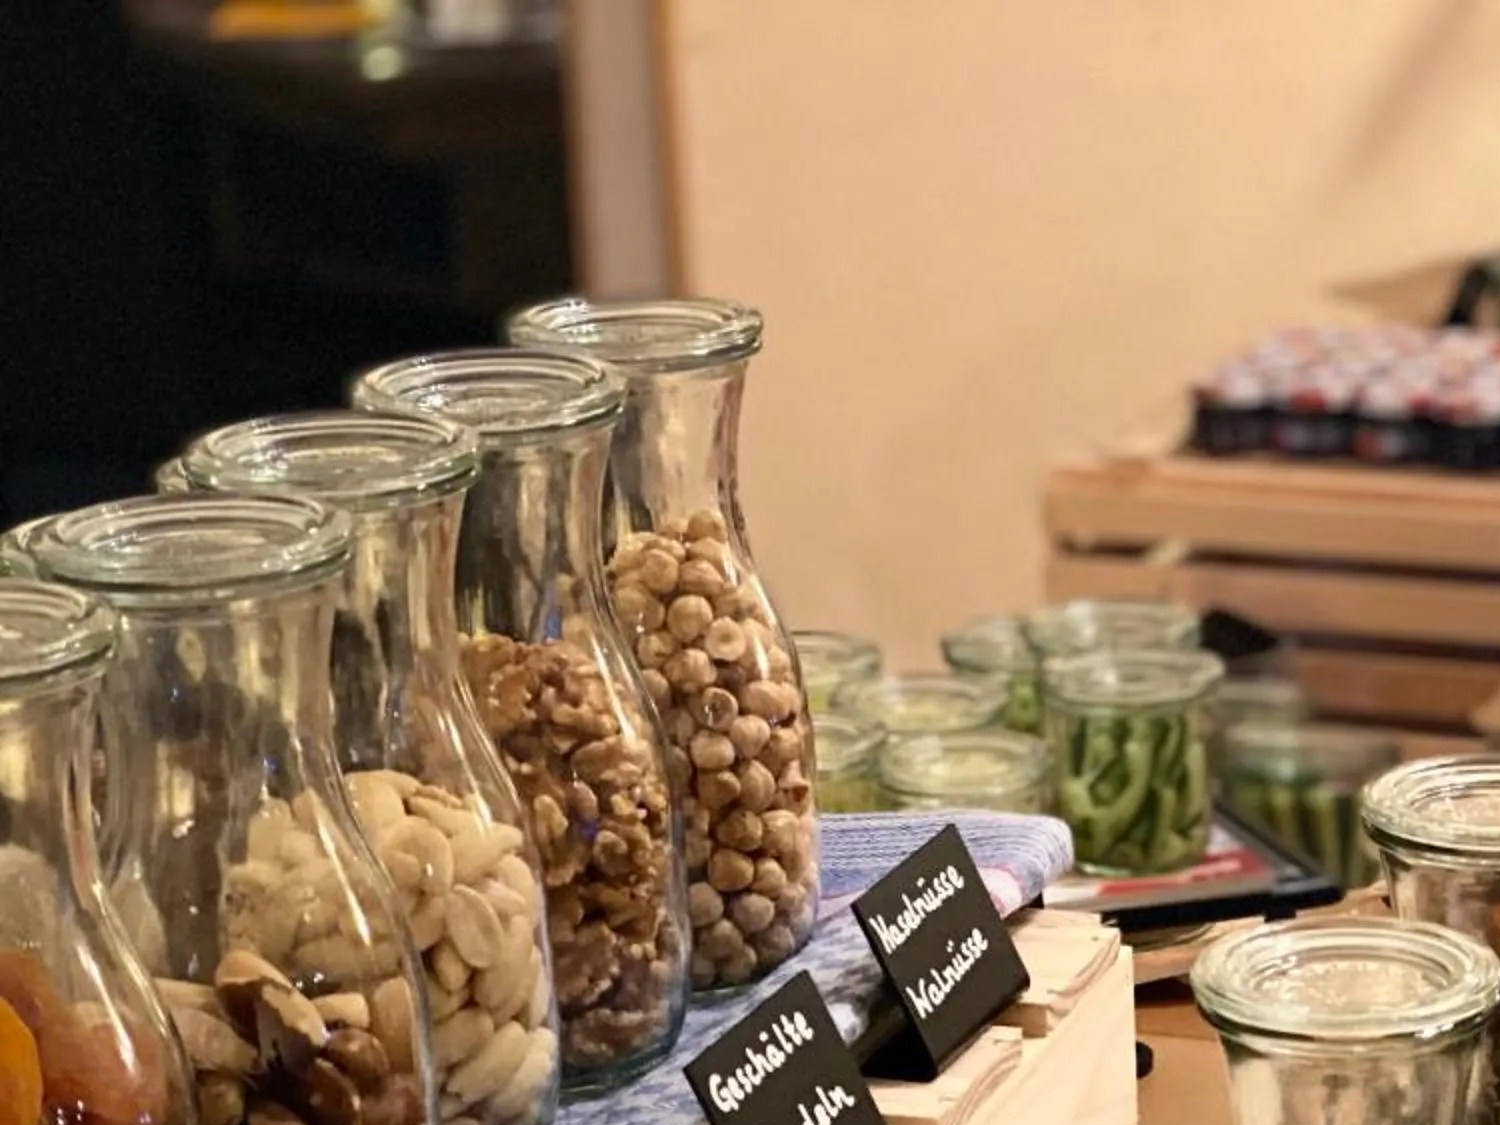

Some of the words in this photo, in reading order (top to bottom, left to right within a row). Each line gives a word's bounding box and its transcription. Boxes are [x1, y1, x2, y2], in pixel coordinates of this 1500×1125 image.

[869, 865, 965, 954] Haselnüsse
[905, 928, 989, 1019] Walnüsse
[708, 1011, 814, 1113] Geschälte
